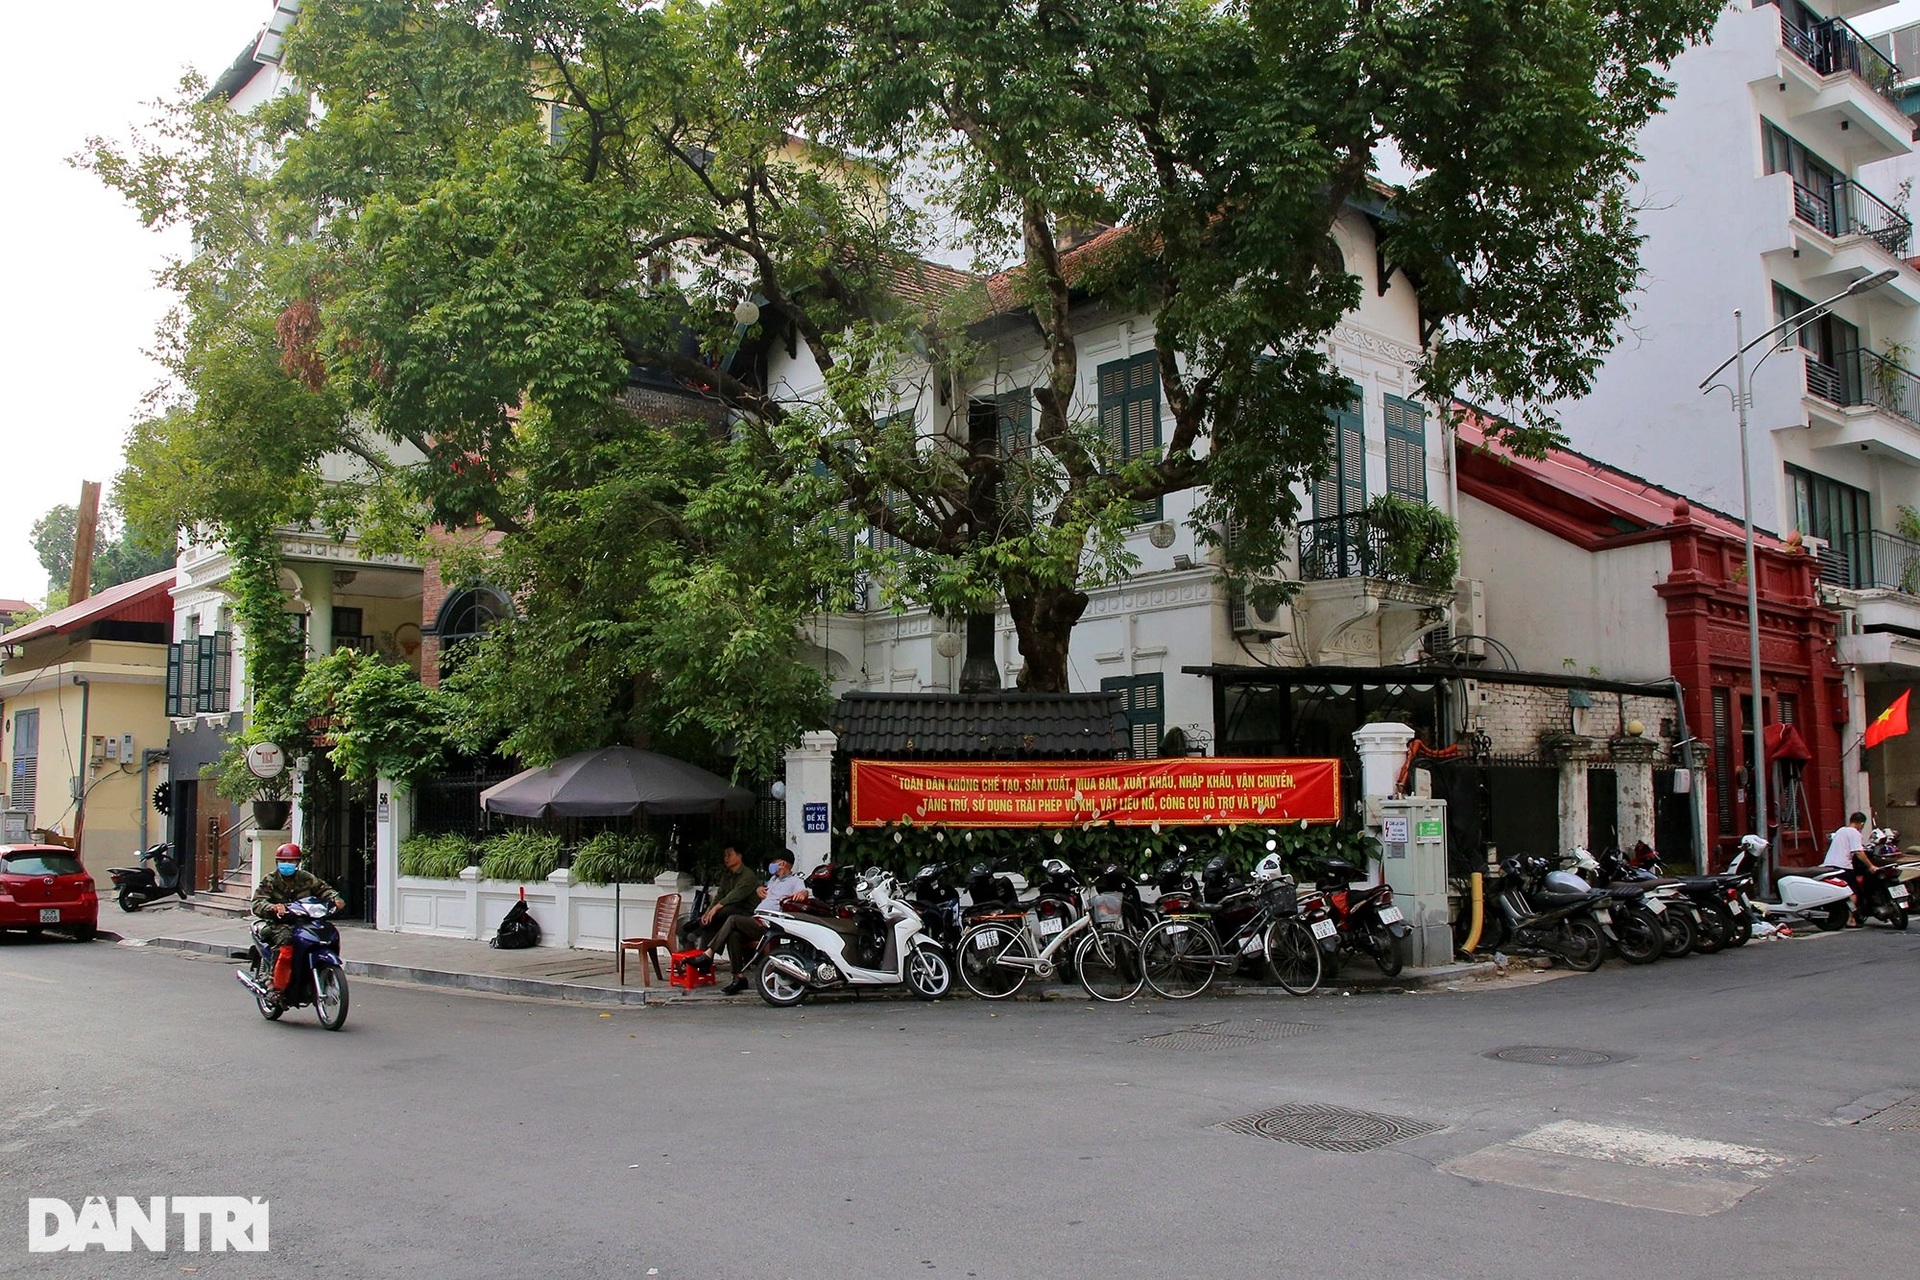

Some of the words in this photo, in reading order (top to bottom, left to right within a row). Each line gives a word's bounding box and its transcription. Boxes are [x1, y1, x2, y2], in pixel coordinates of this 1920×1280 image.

[926, 775, 945, 791] DÂN
[947, 775, 979, 791] KHÔNG
[981, 775, 1000, 791] CHẾ
[1001, 776, 1022, 794] TẠO,
[1024, 774, 1044, 791] SẢN
[1046, 774, 1073, 792] XUẤT,
[1076, 774, 1096, 791] MUA
[1099, 774, 1121, 791] BÁN,
[1123, 772, 1146, 789] XUẤT
[1149, 772, 1177, 790] KHẨU,
[1179, 773, 1204, 791] NHẬP
[1207, 772, 1234, 790] KHẨU,
[1236, 773, 1255, 791] VẬN
[1257, 772, 1297, 790] CHUYỂN,
[379, 792, 388, 805] 56
[923, 796, 947, 812] TÀNG
[949, 796, 970, 813] TRỮ,
[972, 795, 985, 811] SỬ
[987, 798, 1013, 815] DỤNG
[1015, 797, 1036, 812] TRÁI
[1038, 796, 1062, 812] PHÉP
[1100, 796, 1118, 813] VẬT
[1119, 795, 1139, 813] LIỆU
[1141, 792, 1157, 811] NỔ,
[1160, 793, 1185, 810] CÔNG
[1188, 795, 1201, 812] CỤ
[1203, 792, 1215, 809] HỖ
[1217, 795, 1235, 812] TRỢ
[1237, 794, 1249, 809] VÀ
[817, 814, 826, 822] XE
